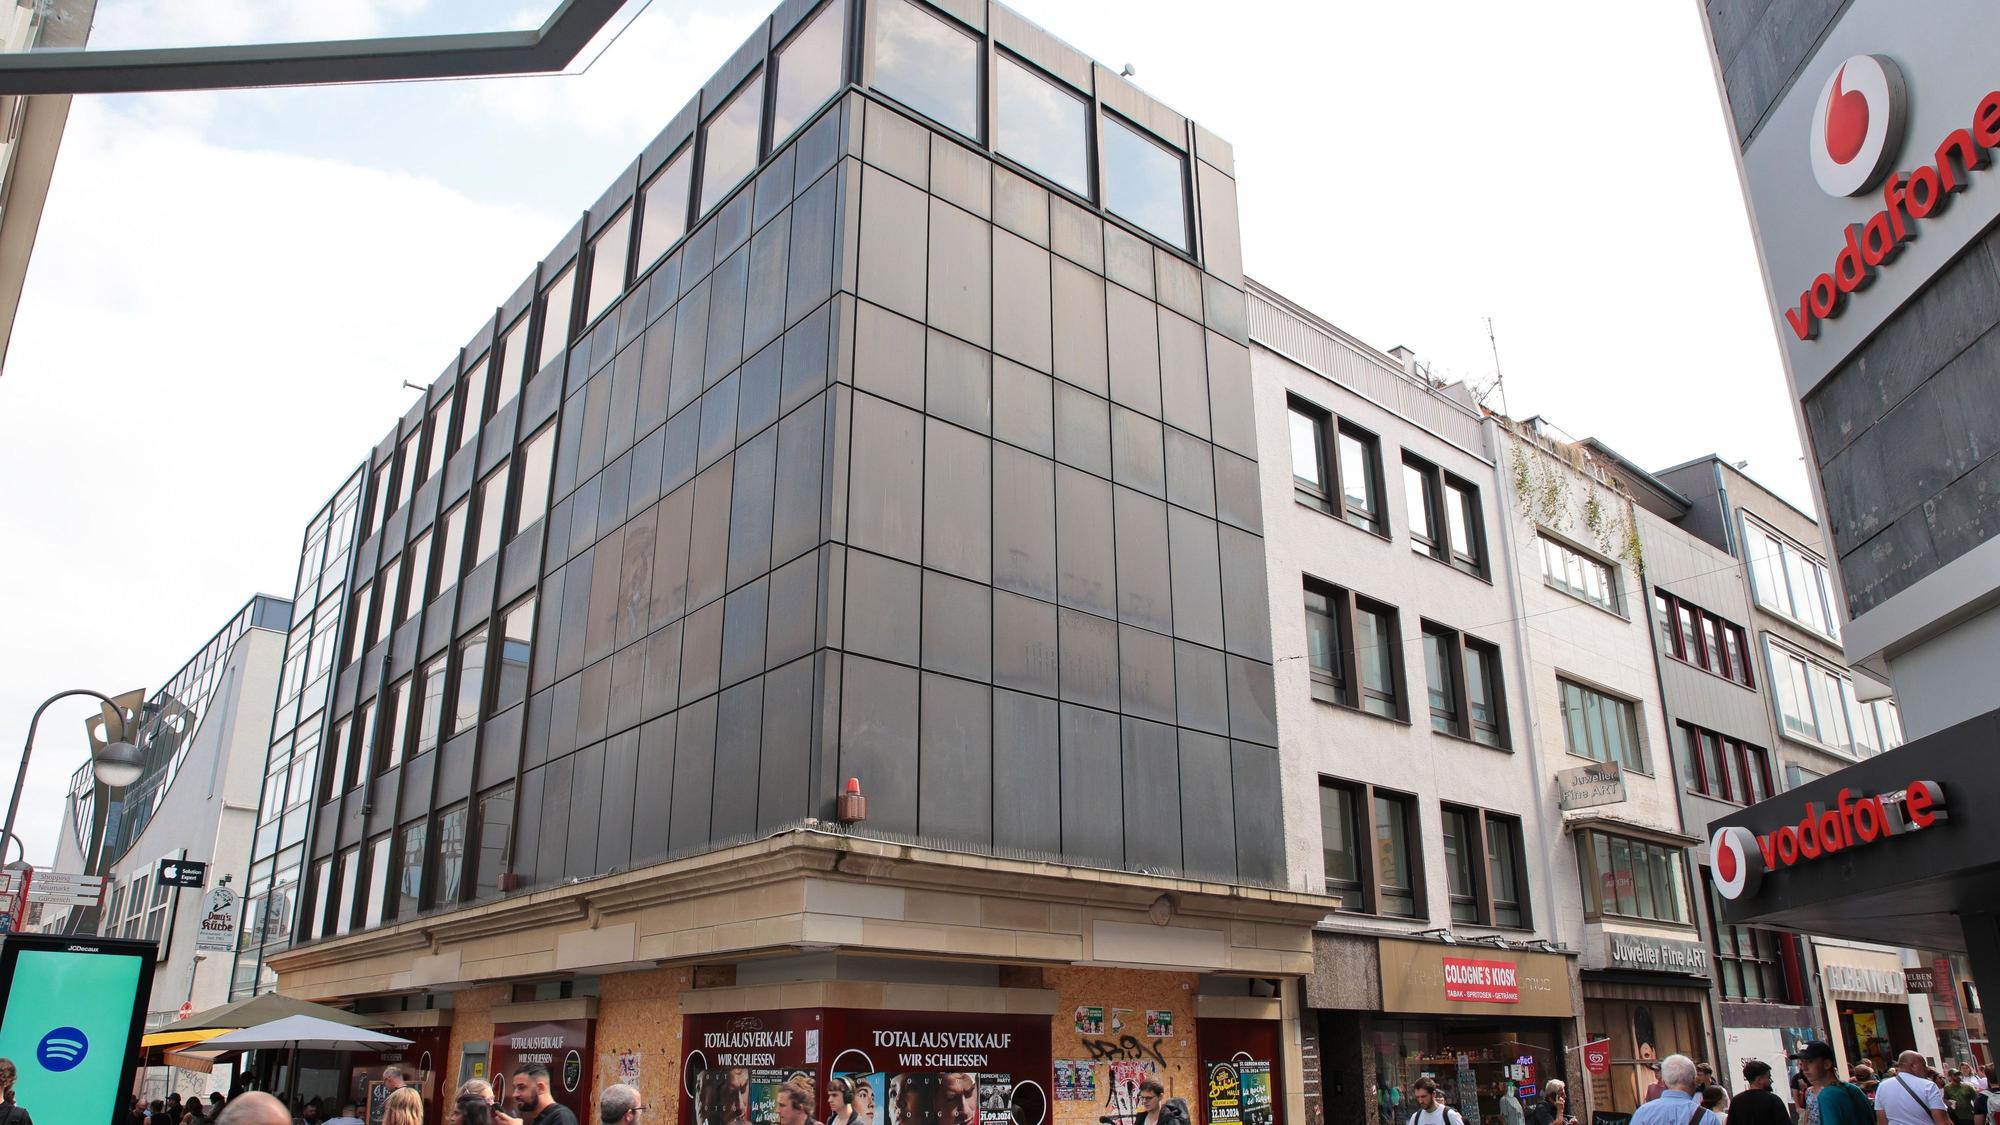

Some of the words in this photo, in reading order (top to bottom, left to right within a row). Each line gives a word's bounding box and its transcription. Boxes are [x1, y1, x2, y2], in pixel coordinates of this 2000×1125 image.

[1785, 90, 2000, 341] vodafone
[1572, 771, 1617, 786] Juwelier
[1562, 788, 1588, 801] Fine
[1591, 782, 1618, 798] ART
[40, 873, 71, 882] Shopping
[38, 884, 70, 892] Neumarkt
[201, 919, 233, 932] Küche
[1613, 940, 1659, 963] Juwelier
[1661, 945, 1684, 965] Fine
[1686, 948, 1706, 967] ART
[1491, 967, 1517, 987] KIOSK
[1906, 973, 1932, 981] ELBEN
[1909, 981, 1934, 989] WALD
[1495, 992, 1518, 1000] GETRÄNKE
[511, 1036, 564, 1050] TOTALAUSVERKAUF
[704, 1030, 793, 1048] TOTALAUSVERKAUF
[873, 1030, 1012, 1049] TOTALAUSVERKAUF
[518, 1053, 528, 1063] WIR
[527, 1053, 553, 1064] SCHLIESSEN
[718, 1053, 733, 1066] WIR
[733, 1053, 775, 1066] SCHLIESSEN
[898, 1053, 923, 1067] WIR
[925, 1053, 988, 1067] SCHLIESSEN
[980, 1112, 1012, 1121] 21.09.2024
[1211, 1108, 1240, 1118] 12.10.2024
